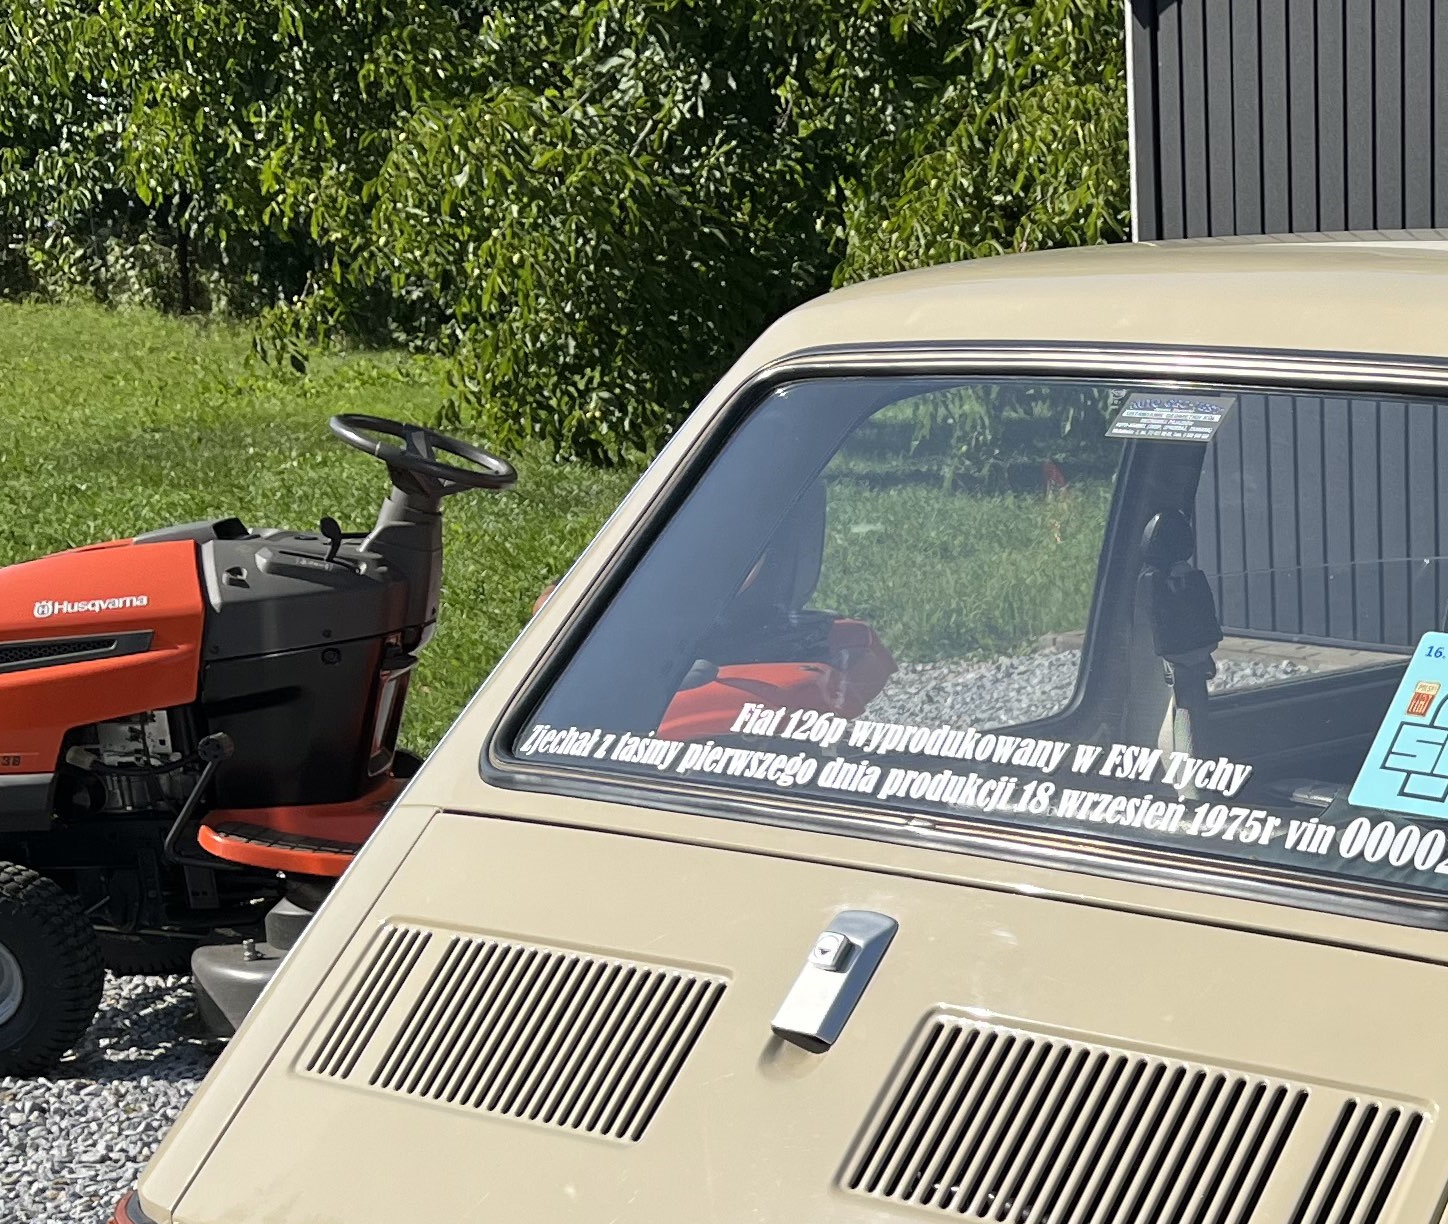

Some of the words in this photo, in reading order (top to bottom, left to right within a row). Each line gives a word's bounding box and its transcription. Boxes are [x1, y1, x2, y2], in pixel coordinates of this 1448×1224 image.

[54, 594, 149, 614] Husqvarna
[1425, 645, 1446, 660] 16.
[730, 702, 787, 738] Fiat
[780, 708, 848, 748] 126p
[847, 719, 1072, 774] wyprodukowany
[1071, 743, 1103, 774] w
[1099, 743, 1164, 782] FSM
[1161, 750, 1253, 798] Tychy
[519, 724, 603, 758] Zjechał
[593, 733, 617, 759] z
[610, 730, 686, 770] taśmy
[676, 740, 818, 787] pierwszego
[817, 756, 882, 794] dnia
[877, 767, 1019, 813] produkcji
[1014, 779, 1056, 815] 18
[1056, 788, 1187, 834] wrzesień
[1186, 802, 1283, 846] 1975r
[1284, 816, 1337, 857] vin
